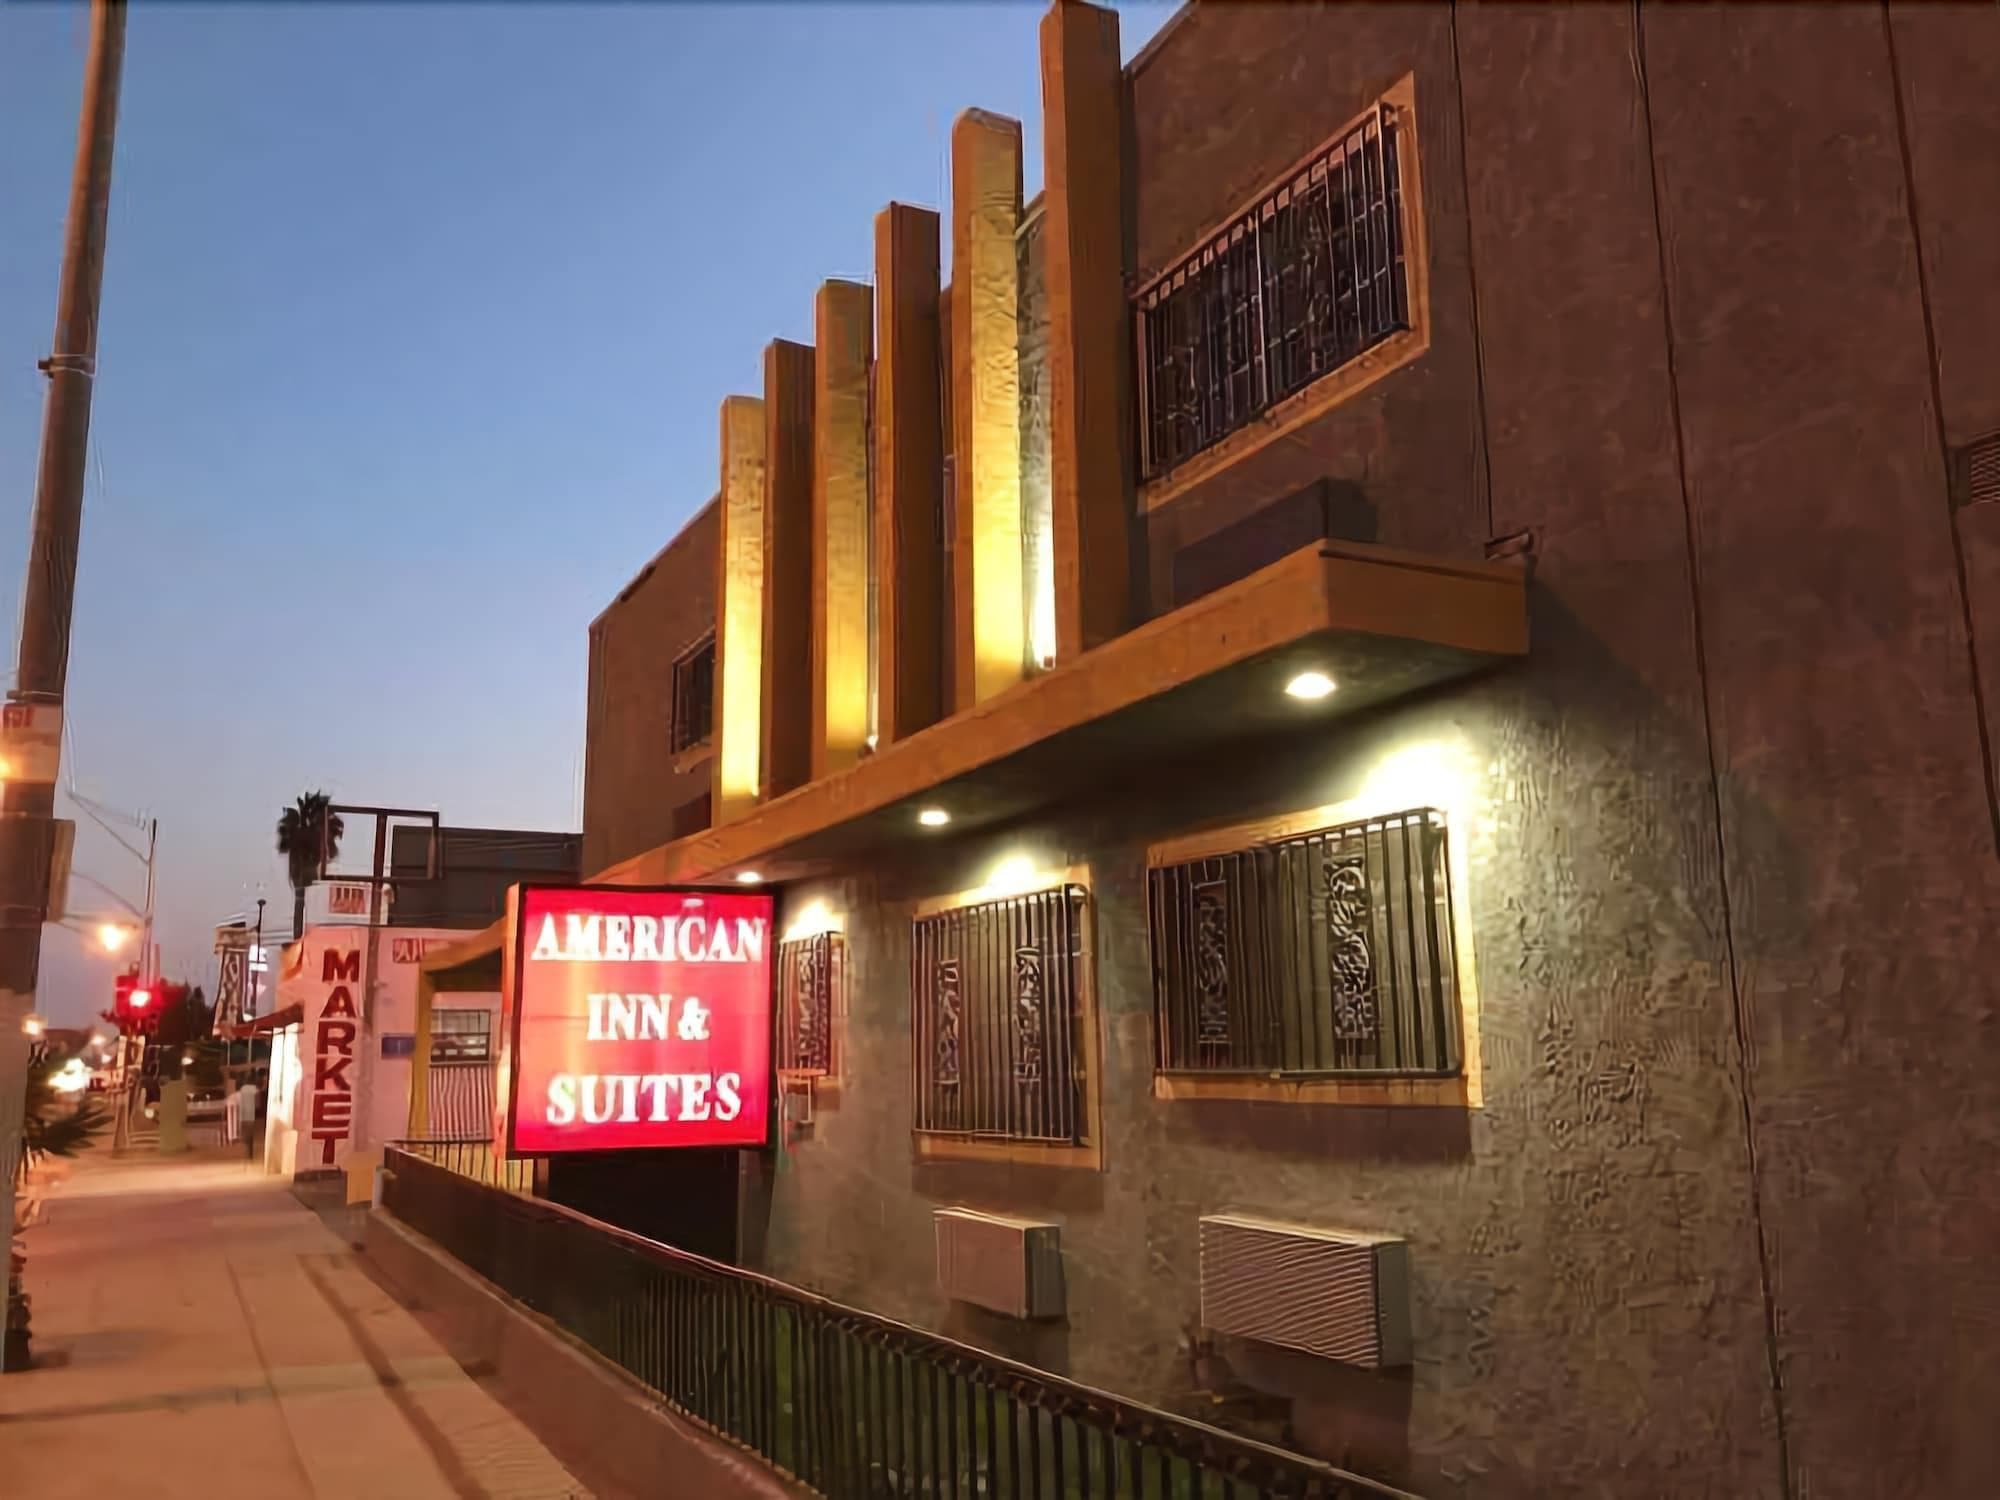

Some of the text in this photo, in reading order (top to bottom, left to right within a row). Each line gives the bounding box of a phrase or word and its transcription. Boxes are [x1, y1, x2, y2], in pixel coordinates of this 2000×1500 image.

[531, 912, 766, 963] AMERICAN
[586, 993, 711, 1041] INN &
[311, 949, 361, 1165] MARKET
[546, 1072, 742, 1126] SUITES
